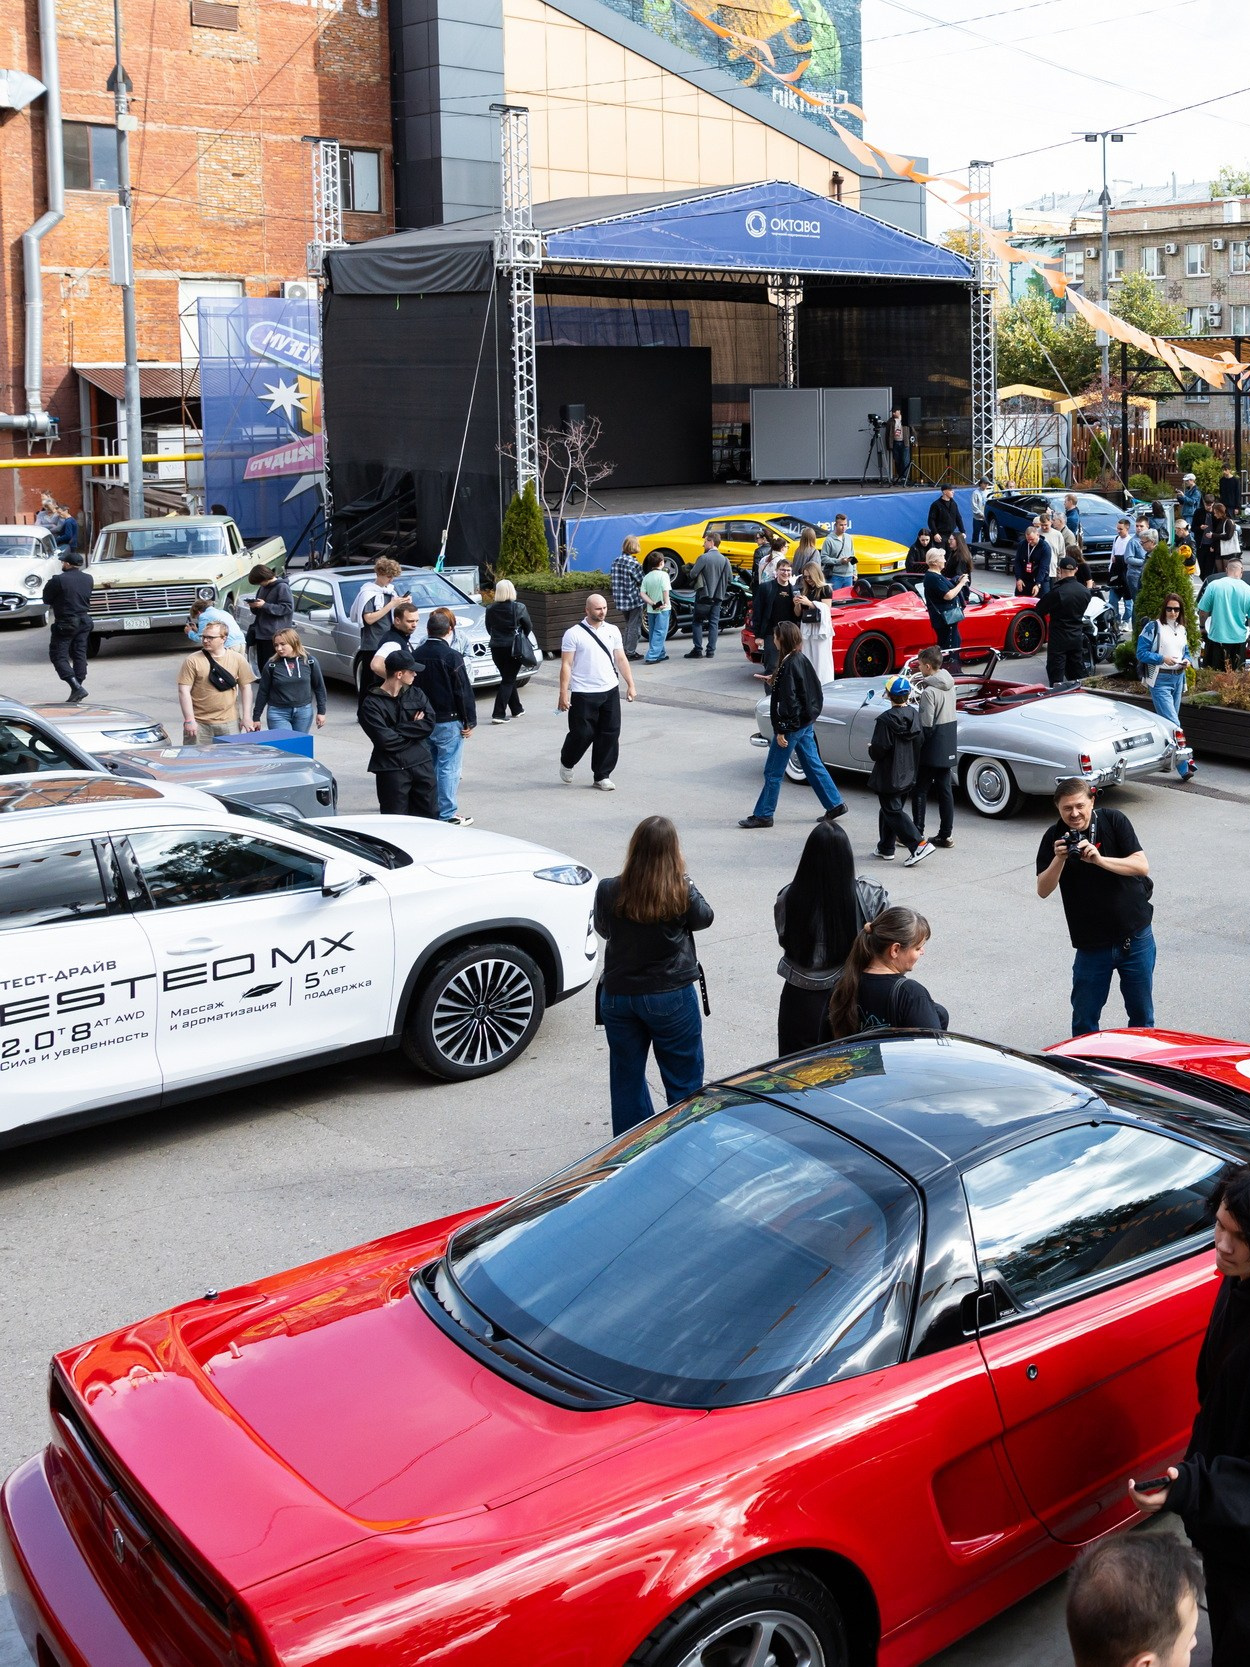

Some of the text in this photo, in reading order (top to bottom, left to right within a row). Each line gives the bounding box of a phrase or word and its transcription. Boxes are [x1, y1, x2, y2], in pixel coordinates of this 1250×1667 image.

[250, 443, 315, 471] СТУДИЯ
[272, 932, 355, 968] MX
[0, 960, 117, 990] ТЕСТ-ДРАЙВ
[305, 965, 346, 990] 5 лет
[304, 980, 373, 1001] поддержка
[115, 1010, 145, 1024] AWD
[170, 1001, 224, 1019] Массаж
[182, 1001, 277, 1030] ароматизация
[0, 1032, 149, 1072] Сила и уверенность
